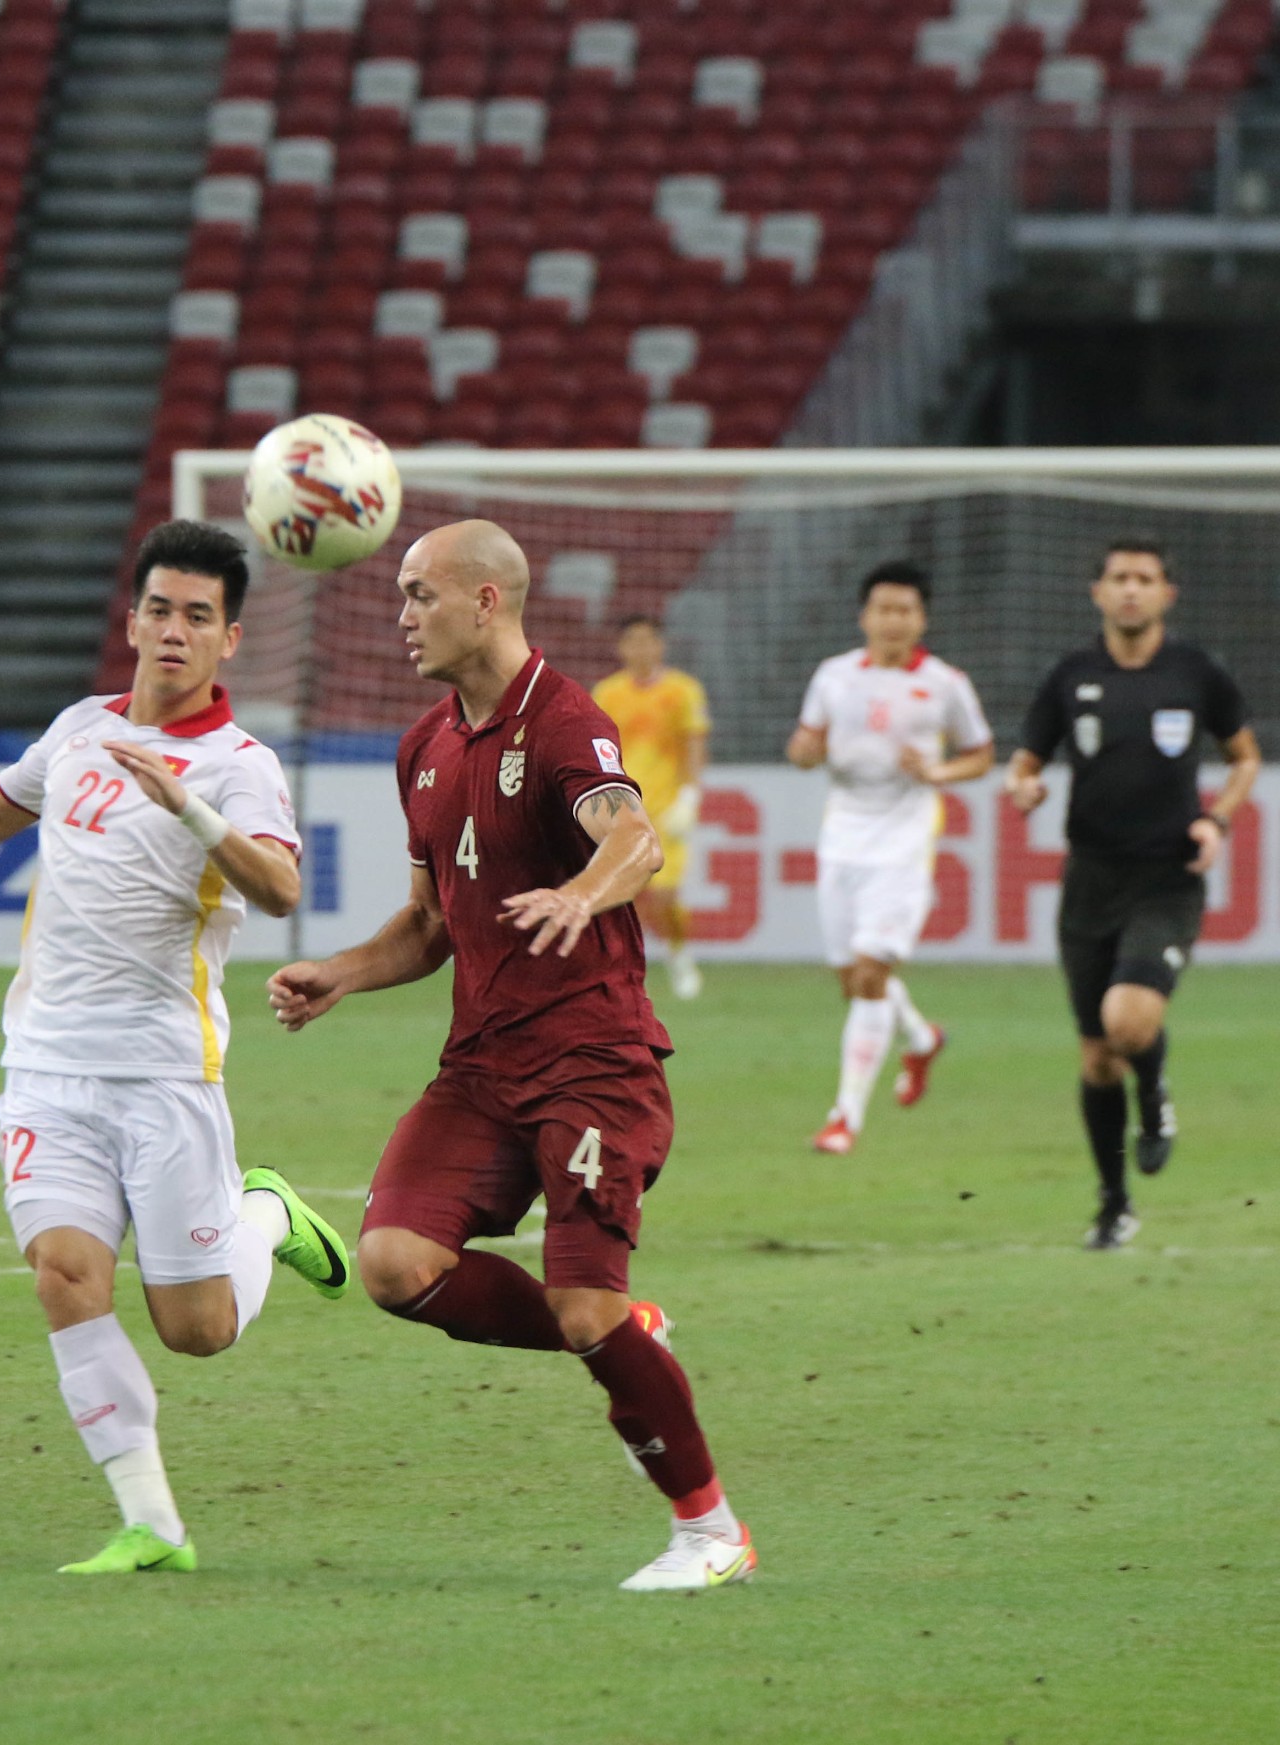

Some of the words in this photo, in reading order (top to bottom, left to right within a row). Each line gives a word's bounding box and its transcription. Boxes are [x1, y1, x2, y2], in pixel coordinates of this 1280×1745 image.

[64, 770, 125, 834] 22
[456, 815, 478, 879] 4
[2, 1126, 36, 1183] 2
[567, 1126, 603, 1190] 4
